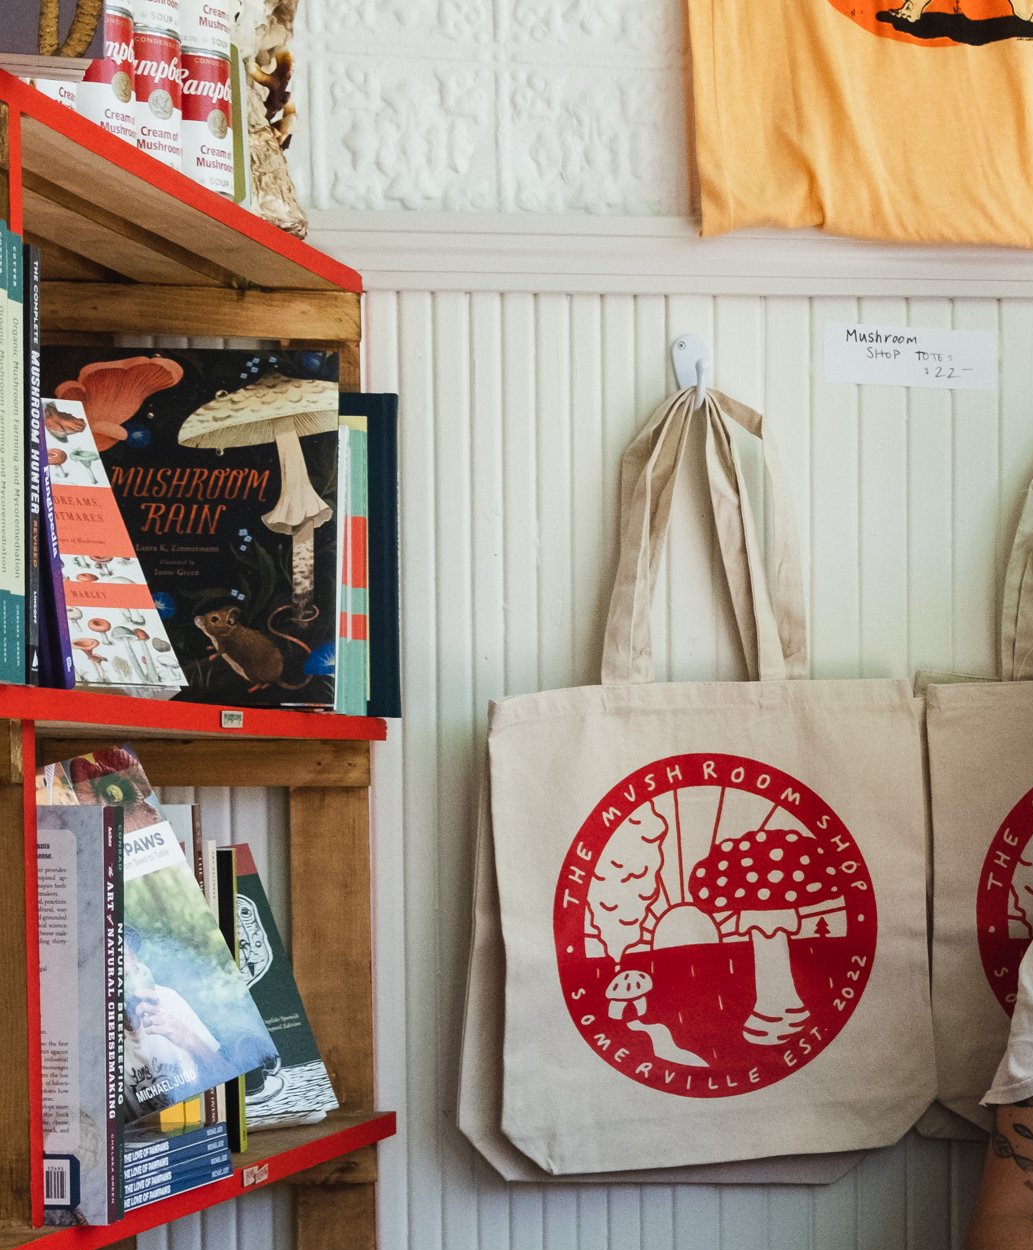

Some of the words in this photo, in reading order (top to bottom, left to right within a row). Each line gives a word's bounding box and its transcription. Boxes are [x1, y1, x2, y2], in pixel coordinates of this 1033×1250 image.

[140, 126, 171, 140] Cream
[200, 145, 227, 159] Cream
[845, 328, 918, 345] Mushroom
[866, 346, 901, 360] SHOP
[31, 350, 41, 444] MUSHROOM
[31, 448, 40, 515] HUNTER
[111, 466, 271, 502] MUSHROOM
[55, 511, 105, 523] TMARES
[140, 502, 227, 536] RAIN
[562, 840, 594, 909] THE
[816, 814, 868, 891] SHOP
[987, 828, 1019, 892] THE
[106, 881, 115, 912] ART
[107, 927, 115, 998] NATURAL
[571, 987, 761, 1091] SOMERVILLE
[833, 954, 867, 1012] 2022
[108, 1002, 116, 1119] CHEESEMAKING
[136, 1079, 174, 1103] MICHAEL
